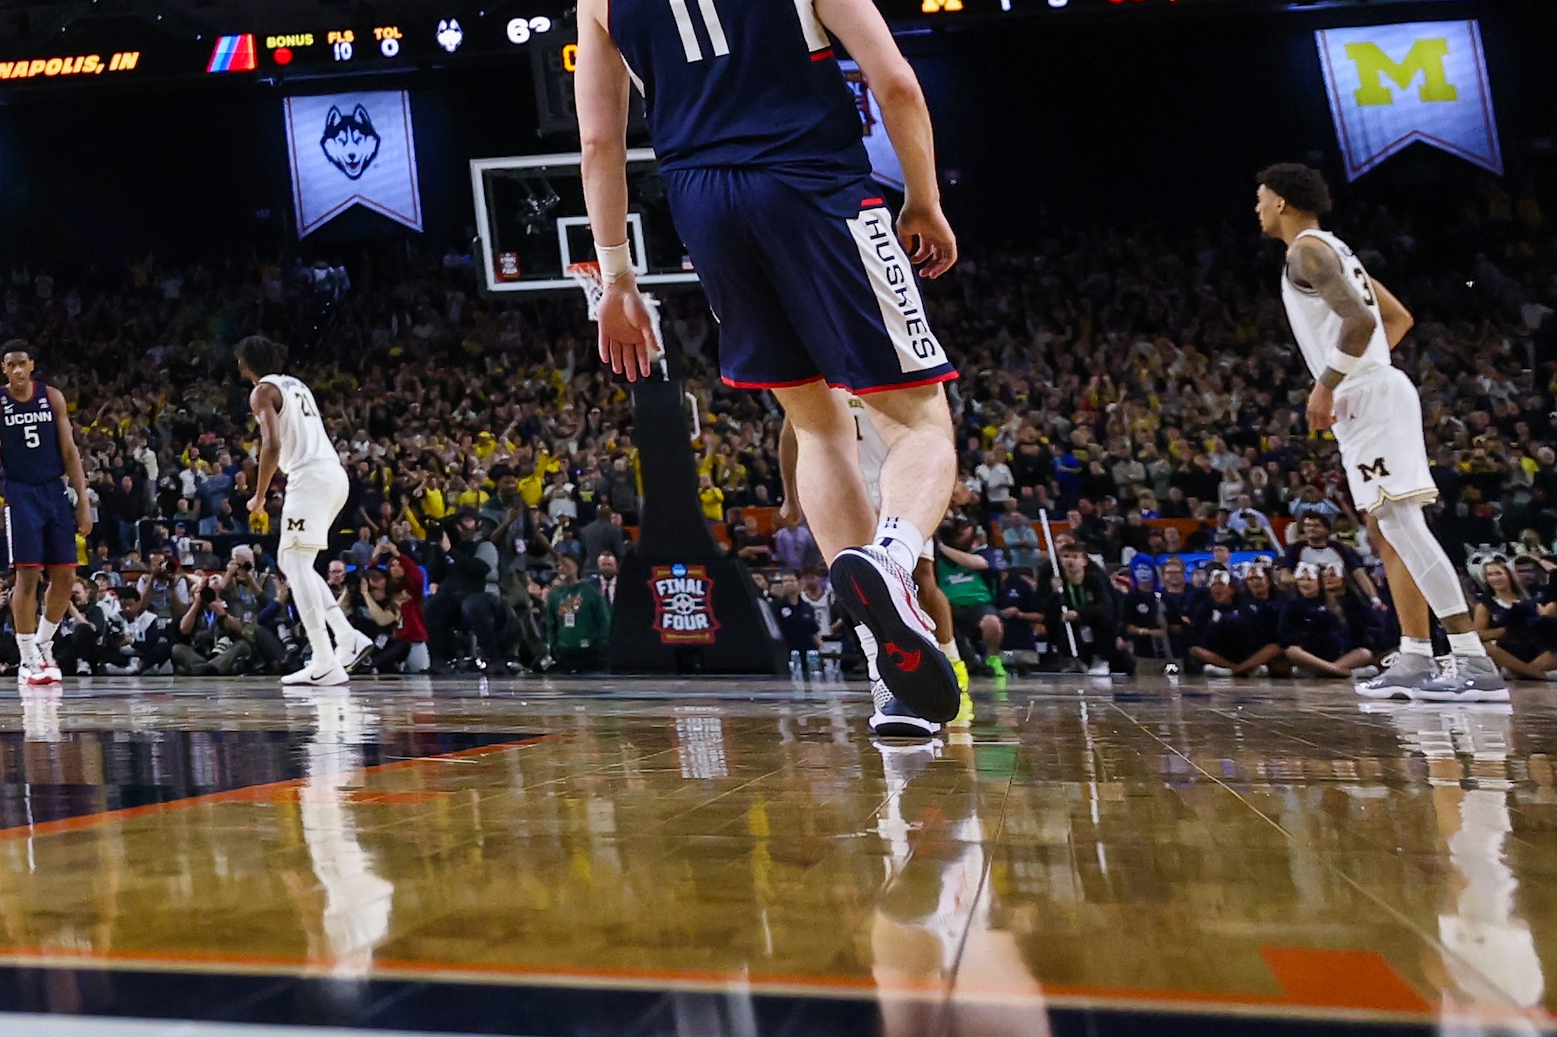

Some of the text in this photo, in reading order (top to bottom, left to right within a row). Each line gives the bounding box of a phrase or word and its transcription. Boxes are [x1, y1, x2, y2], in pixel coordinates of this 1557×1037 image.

[267, 33, 314, 49] BONUS
[328, 30, 355, 44] FLS
[373, 27, 403, 40] TOL
[334, 43, 352, 61] 10
[381, 39, 400, 57] 0
[110, 52, 139, 71] IN
[1345, 37, 1457, 107] M
[865, 217, 936, 359] HUSKIES
[295, 393, 316, 417] 21
[5, 411, 52, 426] UCONN
[24, 425, 40, 448] 5
[1357, 457, 1391, 485] M
[287, 518, 305, 532] M
[655, 578, 705, 597] FINAL
[663, 613, 710, 630] FOUR
